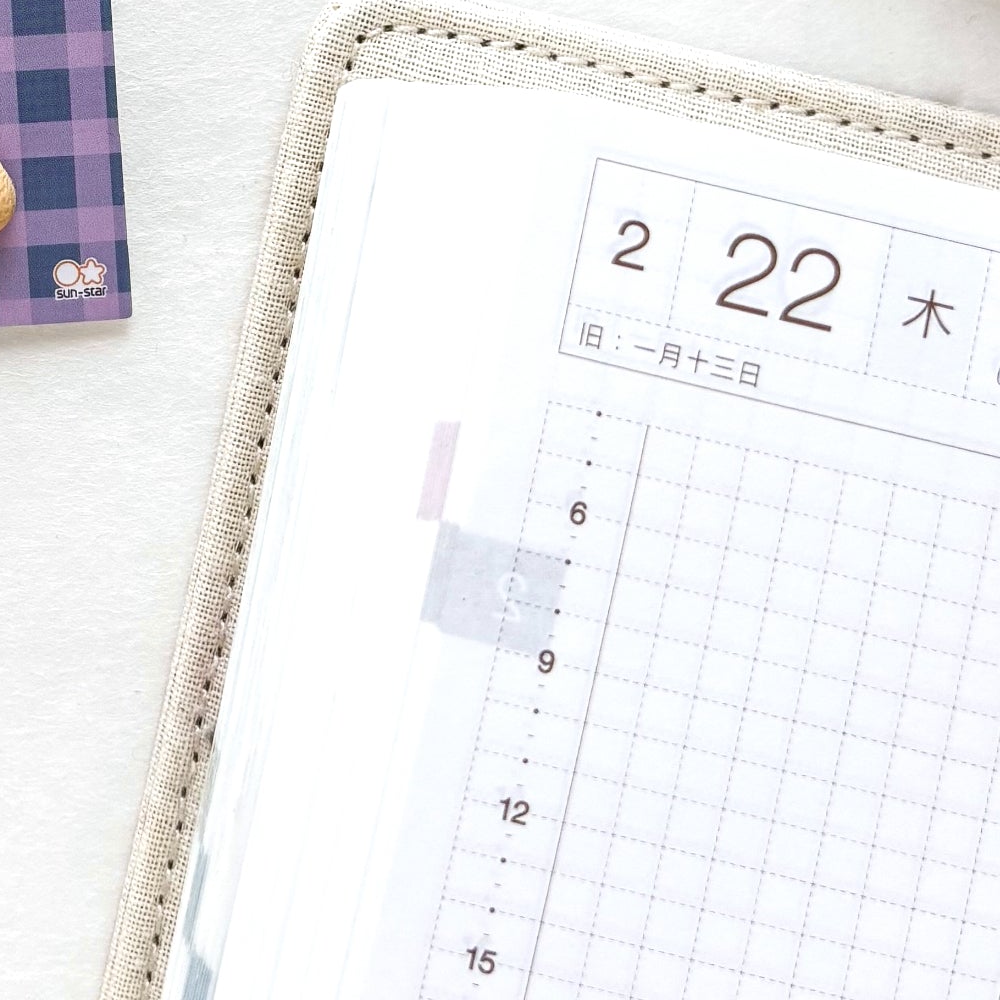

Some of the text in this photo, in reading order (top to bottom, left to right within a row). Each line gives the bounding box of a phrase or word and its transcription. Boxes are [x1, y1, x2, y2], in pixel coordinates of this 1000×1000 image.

[56, 286, 107, 299] sun-star
[611, 220, 955, 339] 2 22 木
[569, 500, 588, 526] 6
[537, 649, 556, 674] 9
[499, 796, 530, 826] 12
[466, 946, 498, 975] 15
